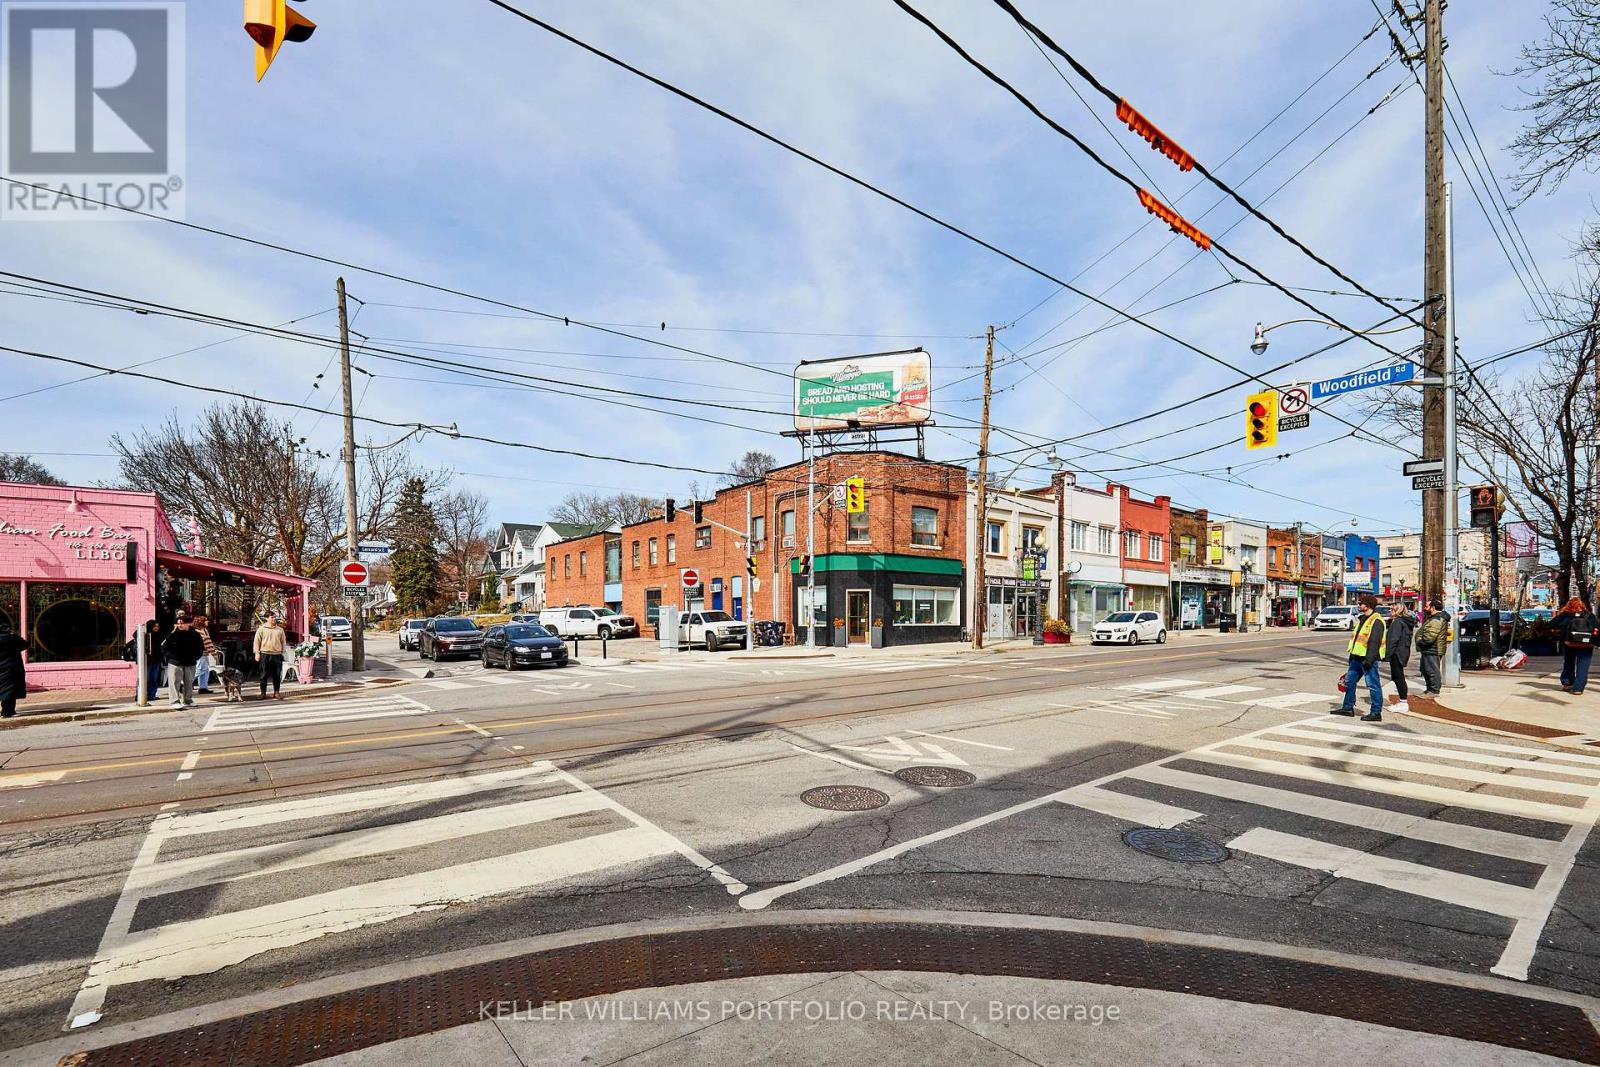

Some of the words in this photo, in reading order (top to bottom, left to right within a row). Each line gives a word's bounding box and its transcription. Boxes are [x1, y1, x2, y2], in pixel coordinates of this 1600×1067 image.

[1319, 368, 1391, 394] Woodfield
[1395, 364, 1406, 375] Rd
[808, 387, 833, 397] BREAD
[833, 385, 850, 394] AND
[851, 382, 885, 392] HOSTING
[802, 396, 832, 406] SHOULD
[832, 393, 857, 402] NEVER
[858, 392, 868, 400] BE
[868, 390, 890, 399] HARD
[1280, 420, 1308, 430] EXCEPTED
[1281, 415, 1307, 424] BICYCLES
[49, 523, 94, 540] Food
[100, 526, 134, 540] Bar
[76, 549, 125, 560] LLBO
